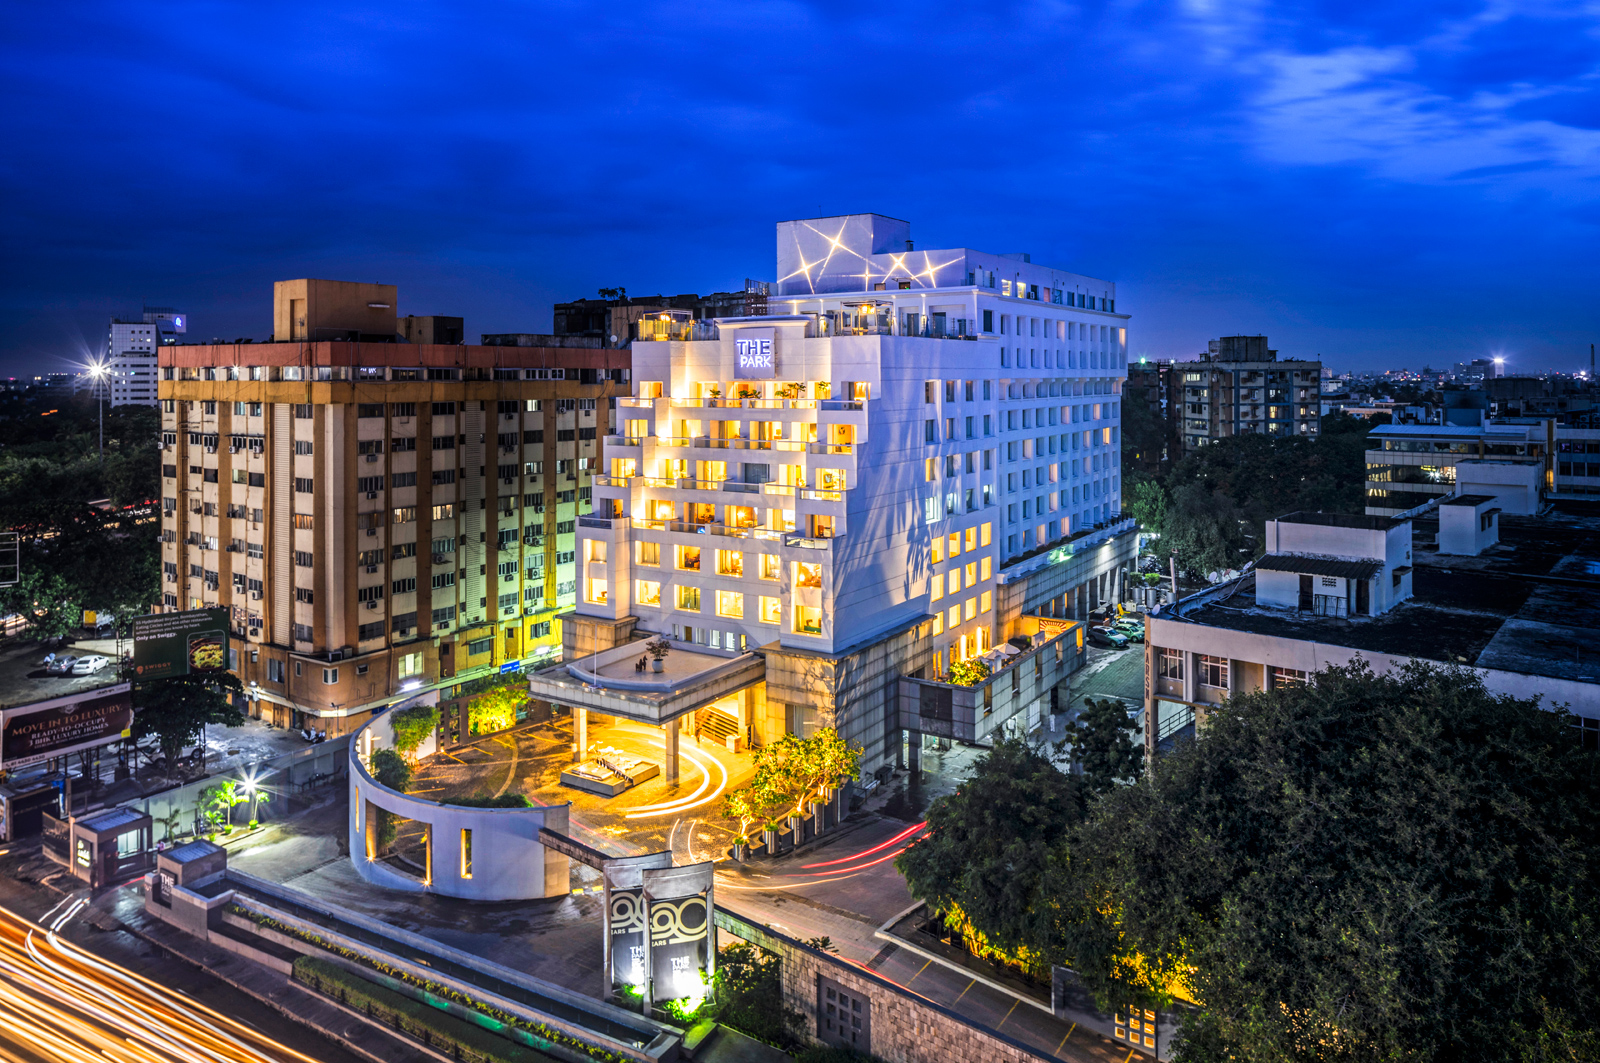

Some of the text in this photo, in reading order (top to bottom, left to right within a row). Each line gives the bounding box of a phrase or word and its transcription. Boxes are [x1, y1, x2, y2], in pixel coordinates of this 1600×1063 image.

[736, 339, 772, 355] THE
[740, 355, 772, 368] PARK
[12, 704, 123, 736] MOVE IN TO LUXURY.
[31, 717, 107, 739] READY-TO-OCCUPY
[34, 736, 51, 745] BHK
[52, 729, 82, 741] LUXURY
[84, 722, 109, 733] HOMES
[160, 873, 174, 888] THE
[670, 955, 690, 966] THE
